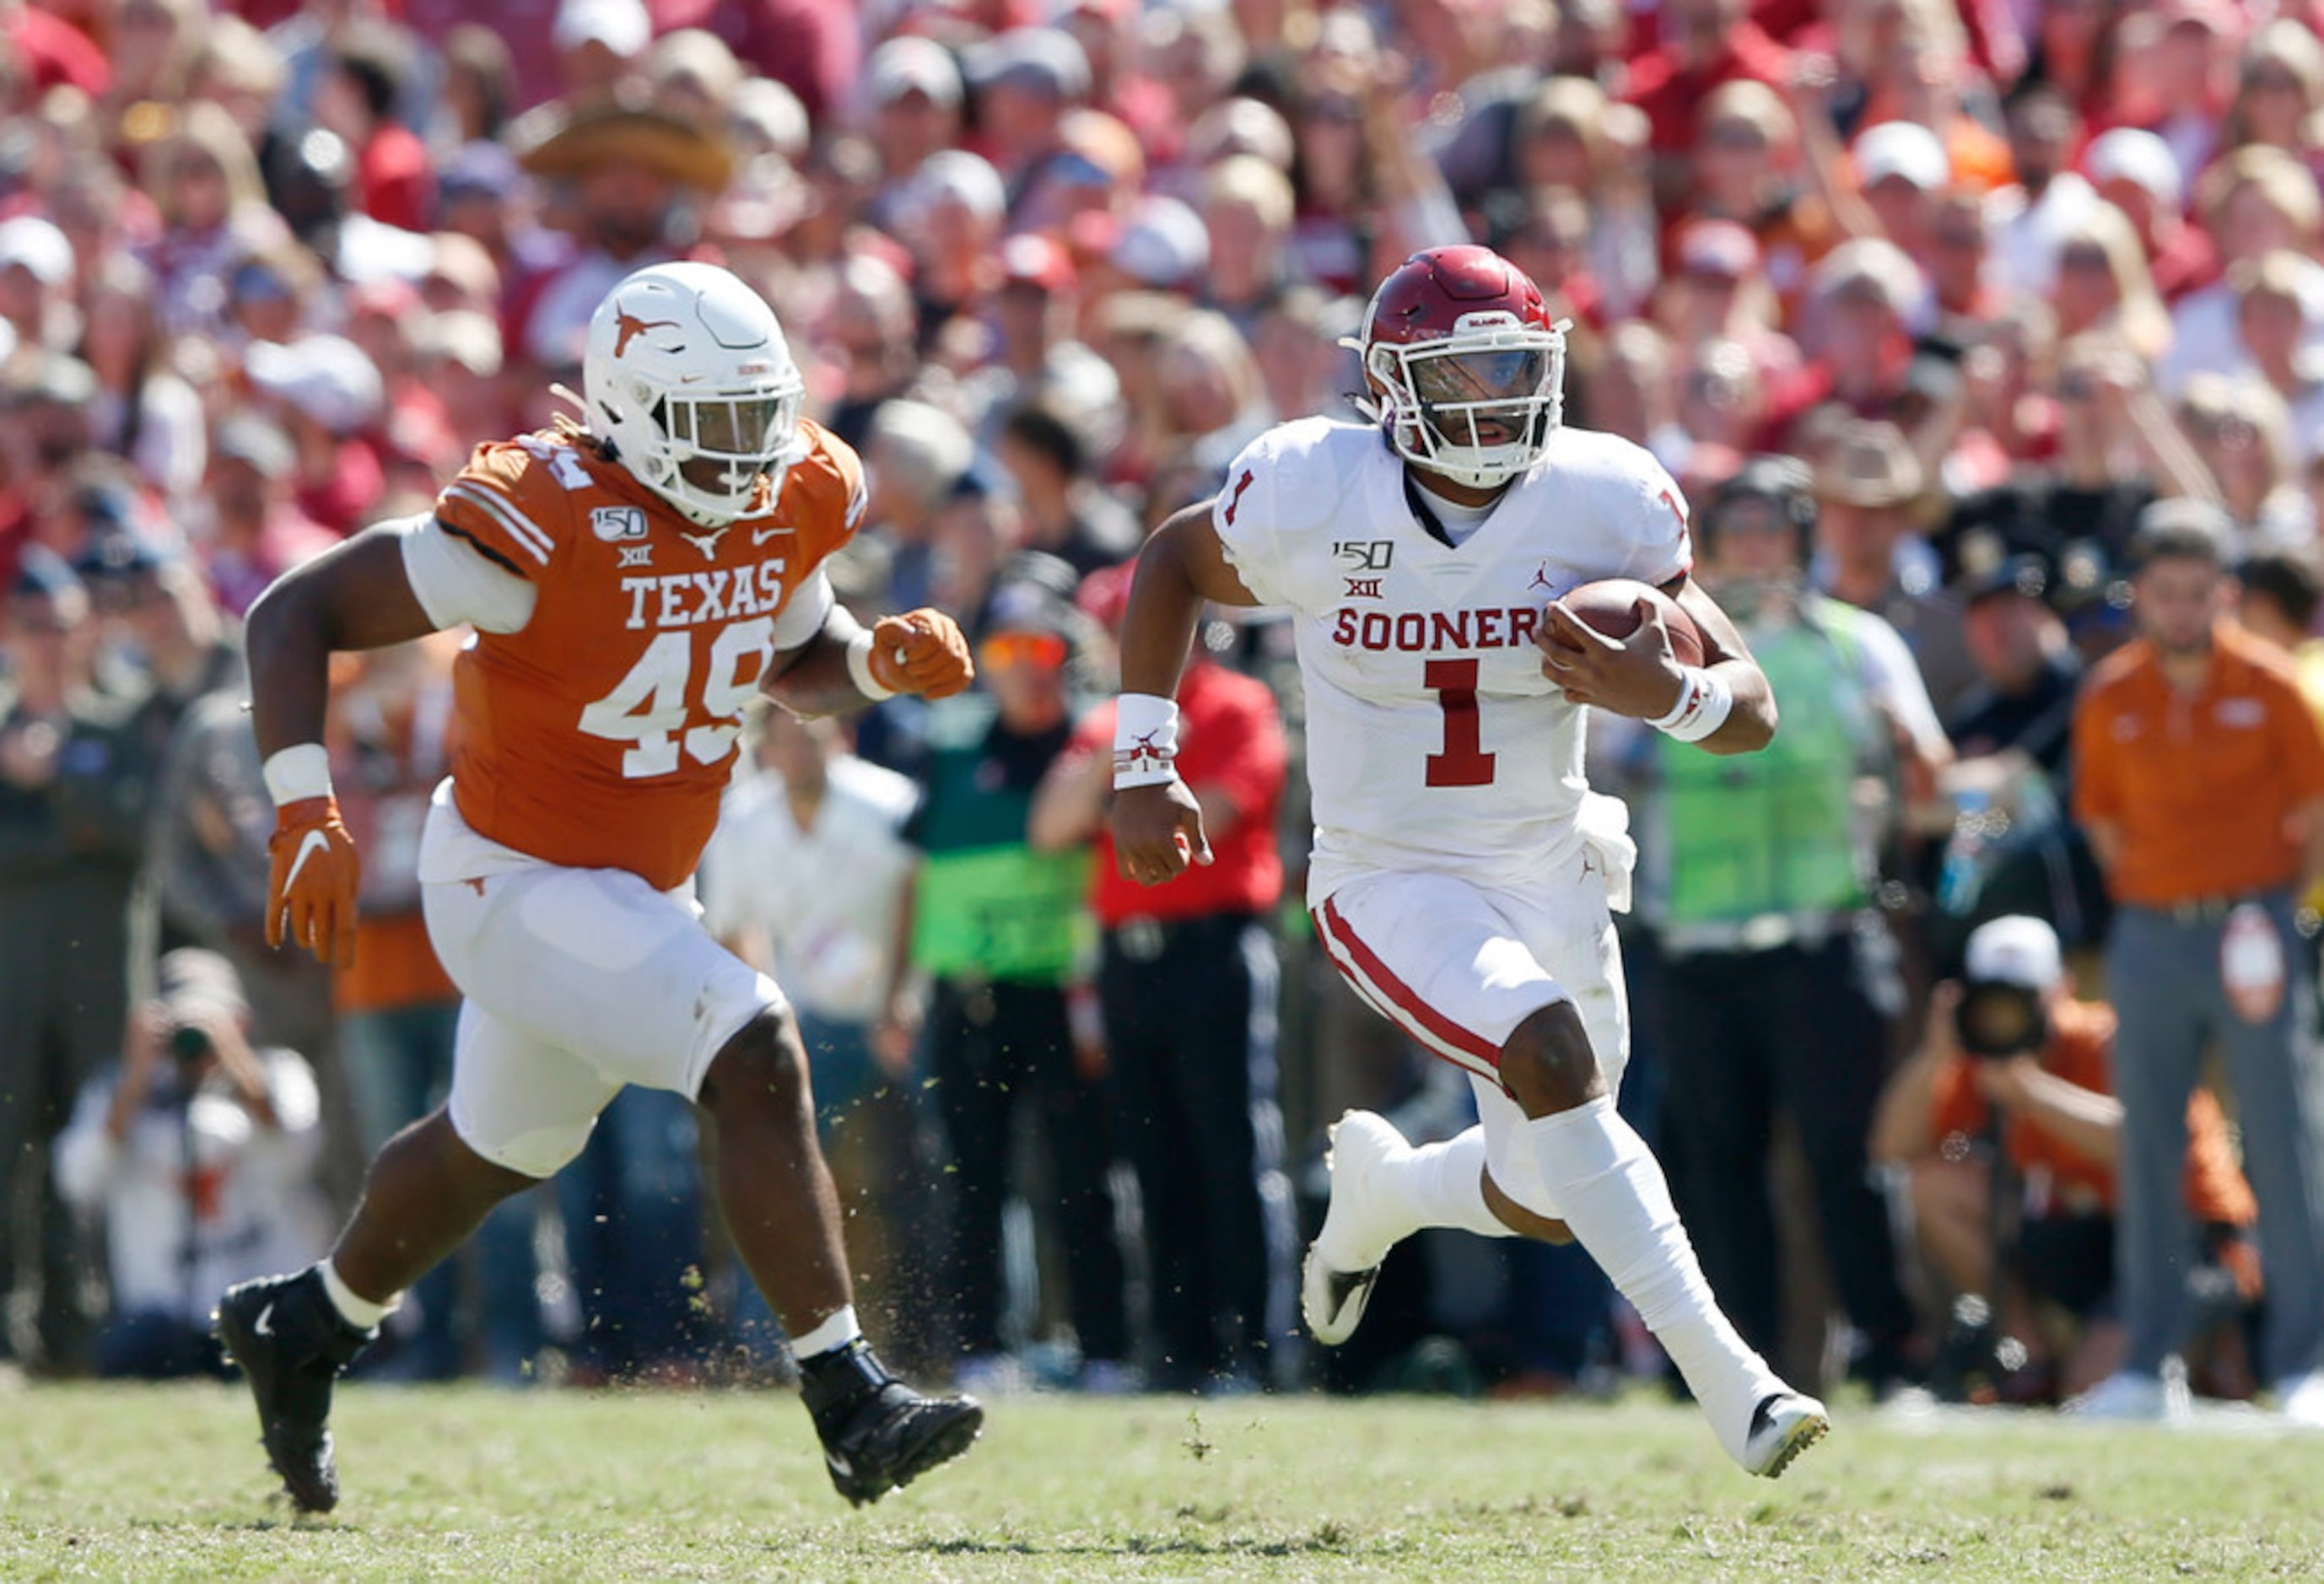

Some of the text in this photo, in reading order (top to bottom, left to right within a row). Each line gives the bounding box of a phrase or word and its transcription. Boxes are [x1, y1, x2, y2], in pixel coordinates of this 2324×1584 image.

[620, 558, 785, 630] TEXAS
[1343, 577, 1384, 600] XII
[1332, 607, 1549, 651] SOONER
[576, 615, 775, 779] 49
[1423, 658, 1496, 788] 1
